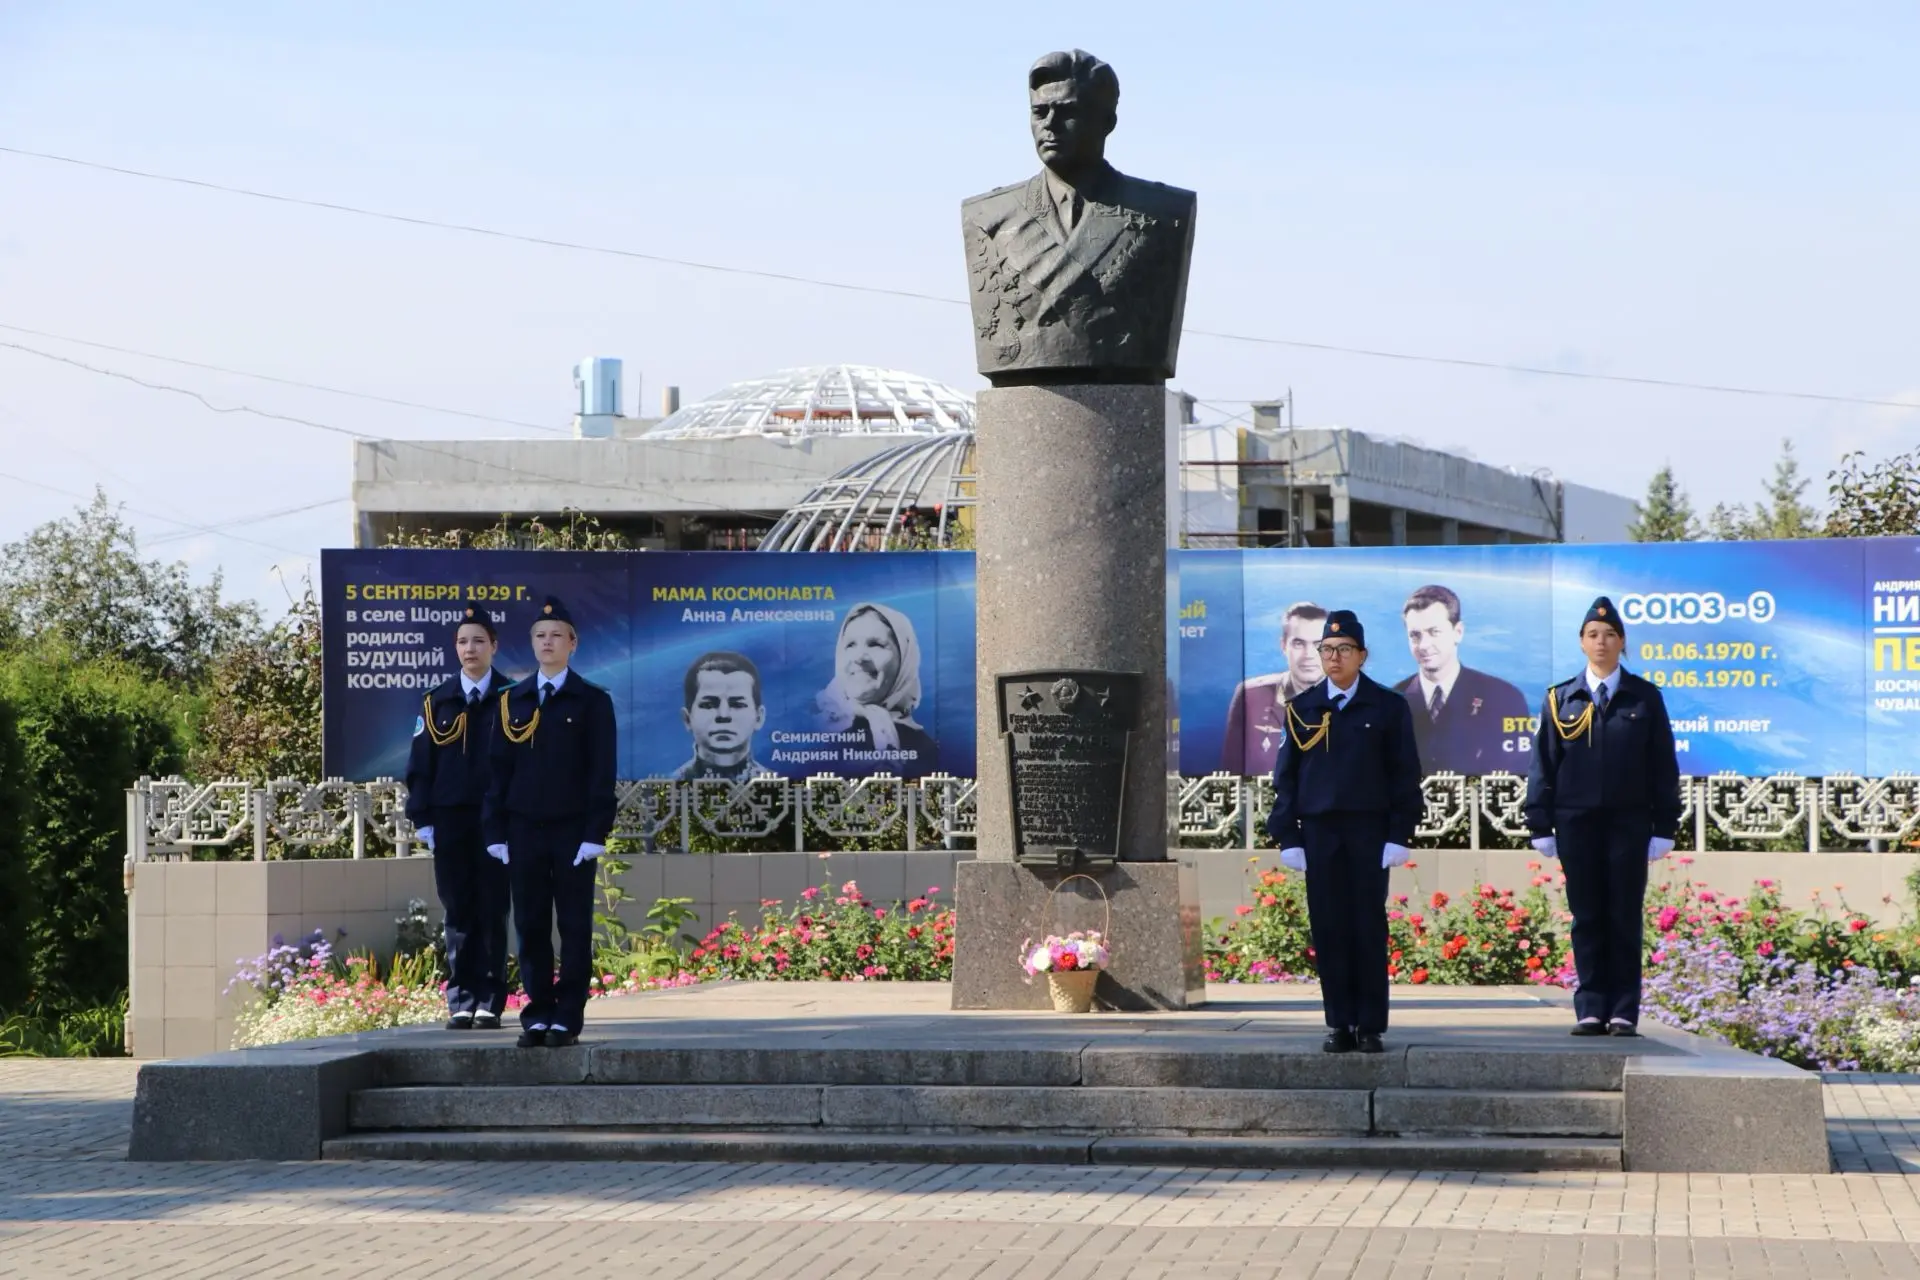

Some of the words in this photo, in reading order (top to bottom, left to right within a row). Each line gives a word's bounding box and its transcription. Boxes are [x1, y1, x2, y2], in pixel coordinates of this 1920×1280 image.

[346, 585, 357, 600] 5
[363, 585, 460, 600] СЕНТЯБРЯ
[467, 585, 510, 600] 1929
[652, 587, 706, 601] МАМА
[712, 586, 835, 601] КОСМОНАВТА
[681, 608, 726, 623] Анна
[731, 608, 835, 623] Алексеевна
[1874, 595, 1920, 622] НИ
[346, 611, 357, 622] в
[363, 611, 406, 622] селе
[346, 632, 424, 647] родился
[347, 648, 444, 669] БУДУЩИЙ
[1641, 643, 1755, 660] 01.06.1970
[1761, 645, 1777, 660] г.
[1875, 637, 1920, 671] ПЕ
[1761, 673, 1777, 687] г.
[1714, 719, 1771, 733] полет
[771, 729, 866, 744] Семилетний
[771, 748, 838, 764] Андриян
[842, 748, 917, 761] Николаев
